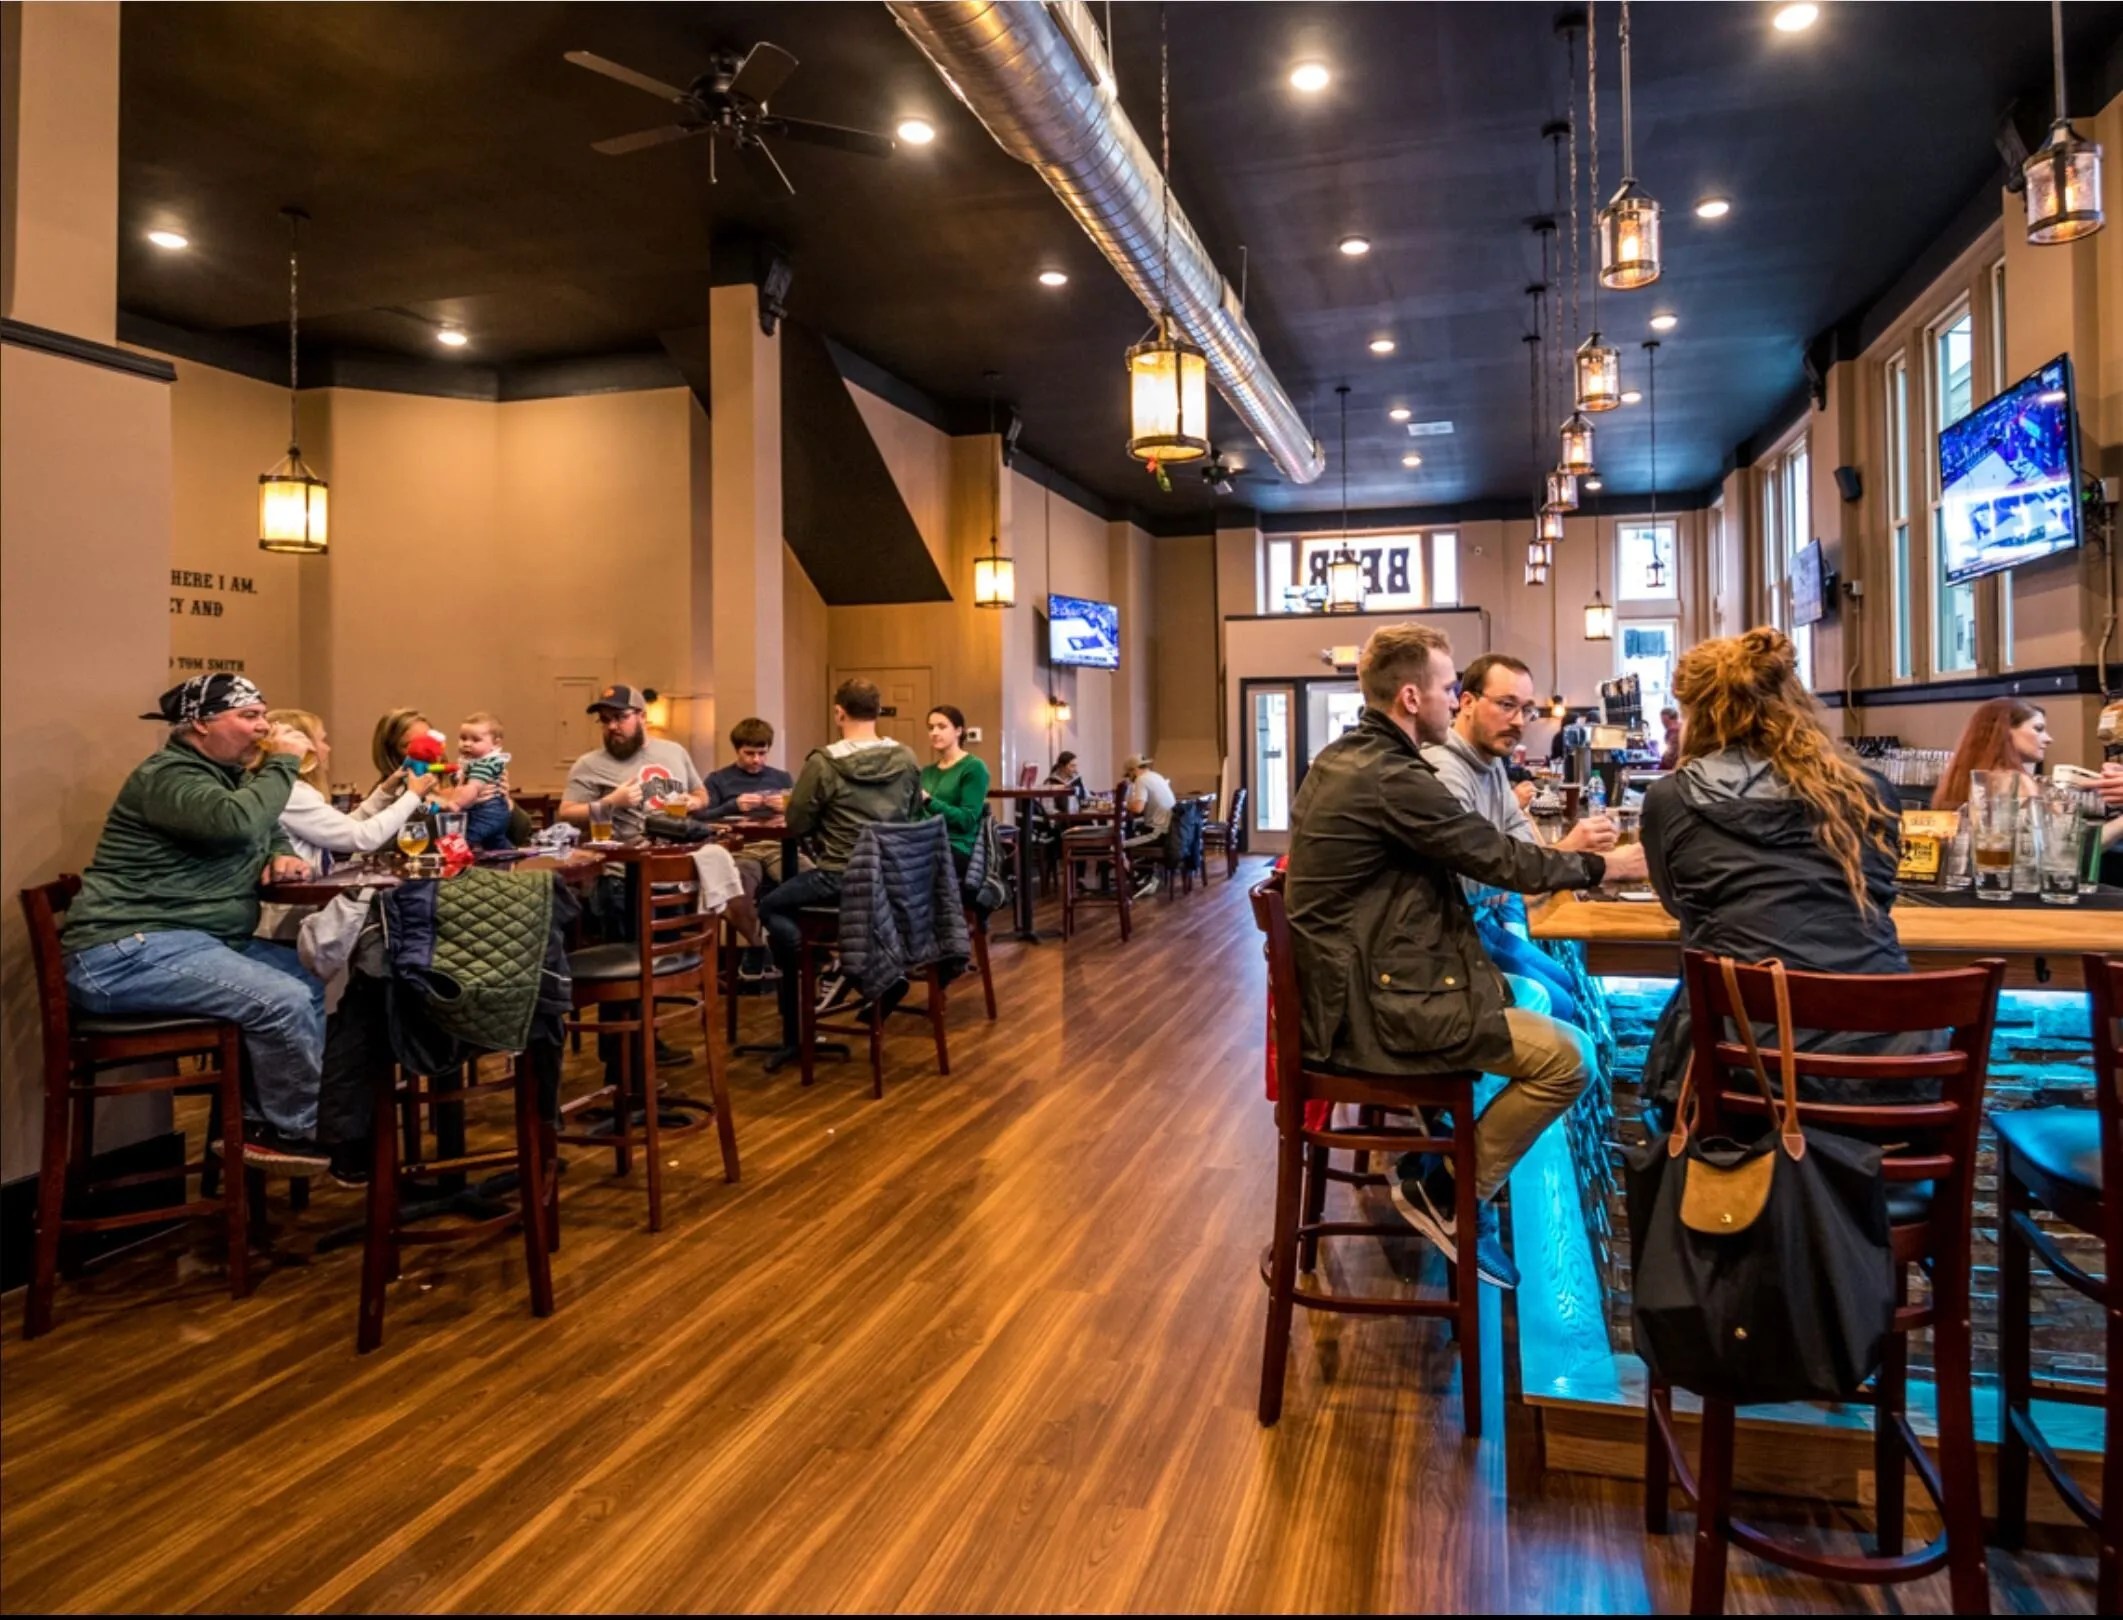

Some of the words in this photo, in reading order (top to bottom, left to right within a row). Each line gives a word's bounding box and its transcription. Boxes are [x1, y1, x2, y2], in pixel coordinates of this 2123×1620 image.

[218, 574, 225, 590] I
[230, 576, 258, 594] AM.
[190, 600, 224, 617] AND
[177, 657, 203, 670] TOM
[207, 658, 245, 672] SMITH
